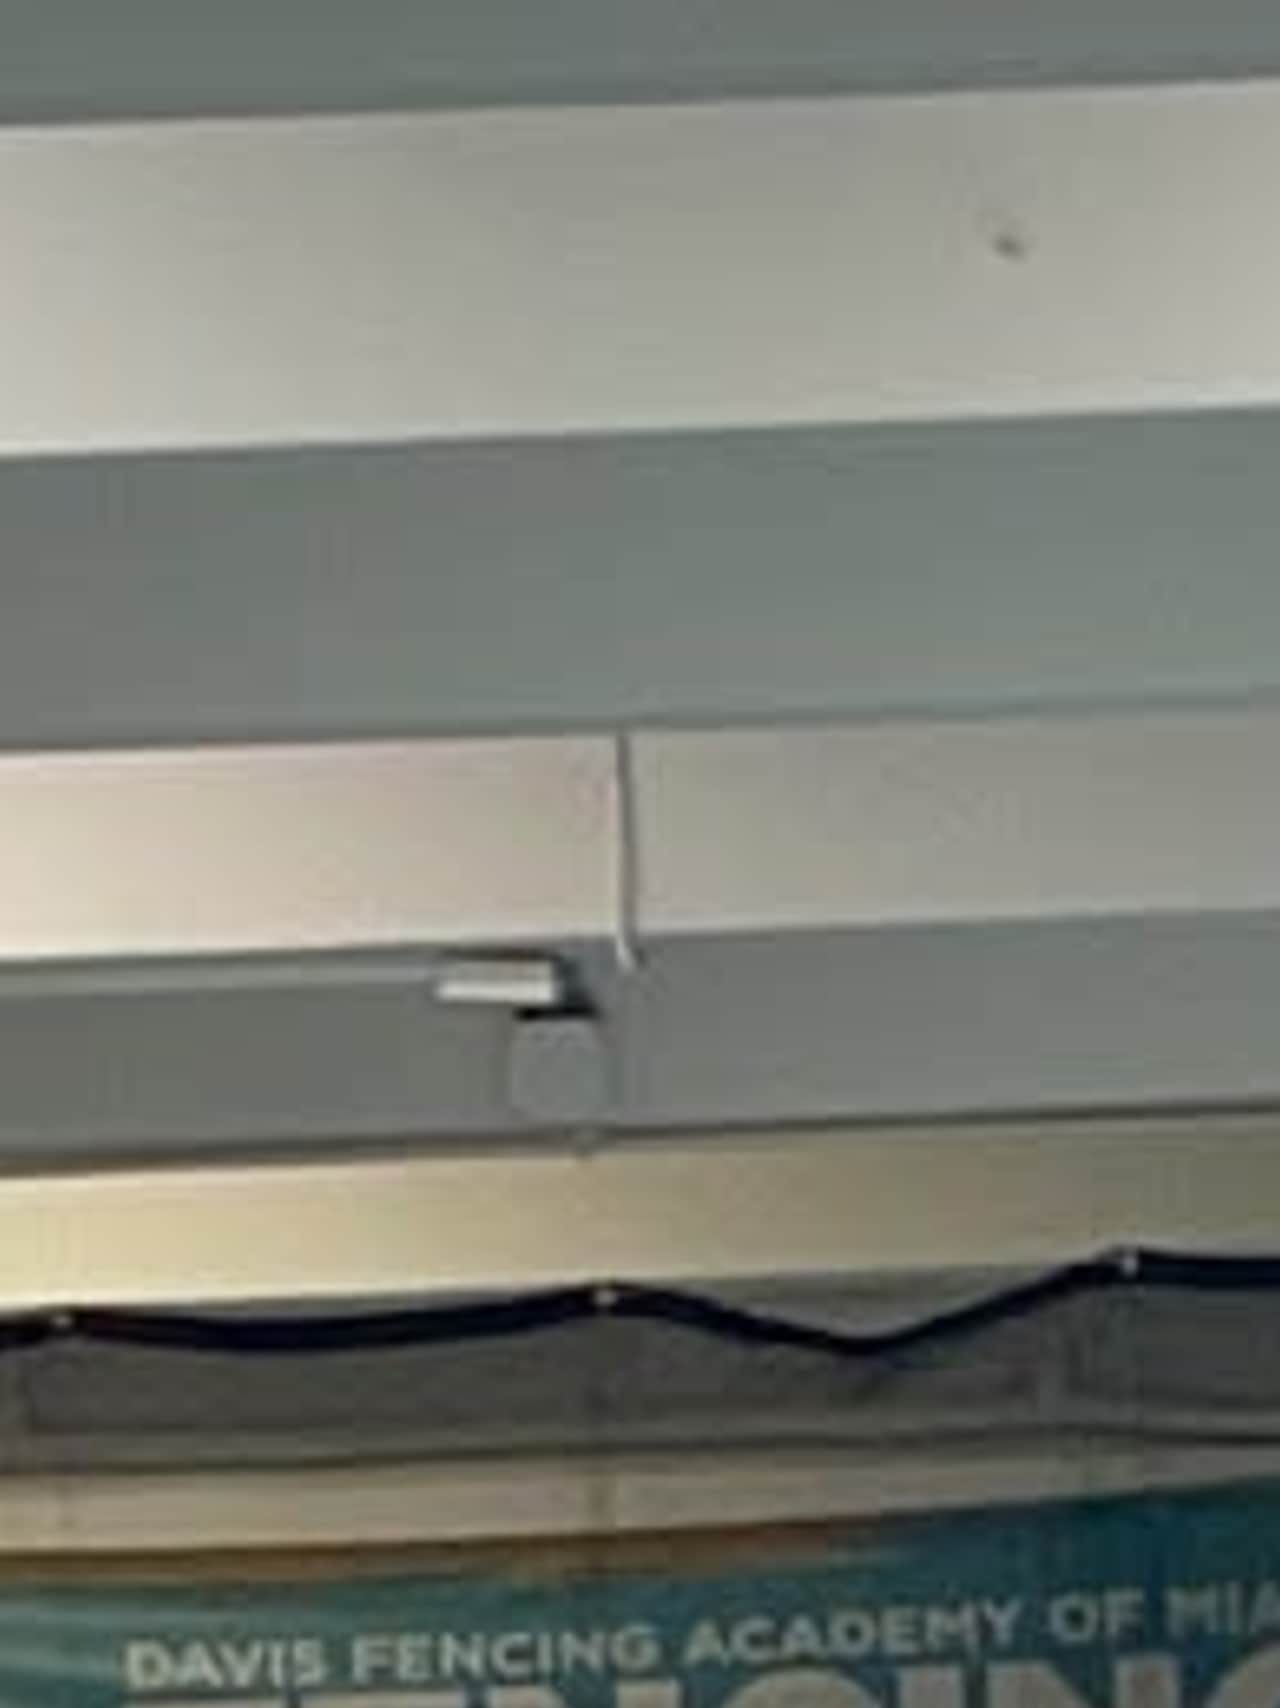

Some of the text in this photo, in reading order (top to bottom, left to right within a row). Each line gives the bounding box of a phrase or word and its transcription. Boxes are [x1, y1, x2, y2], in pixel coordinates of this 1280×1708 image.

[125, 1637, 328, 1690] DAVIS
[352, 1624, 660, 1684] FENCING
[685, 1598, 1024, 1667] ACADEMY
[1047, 1587, 1145, 1643] OF
